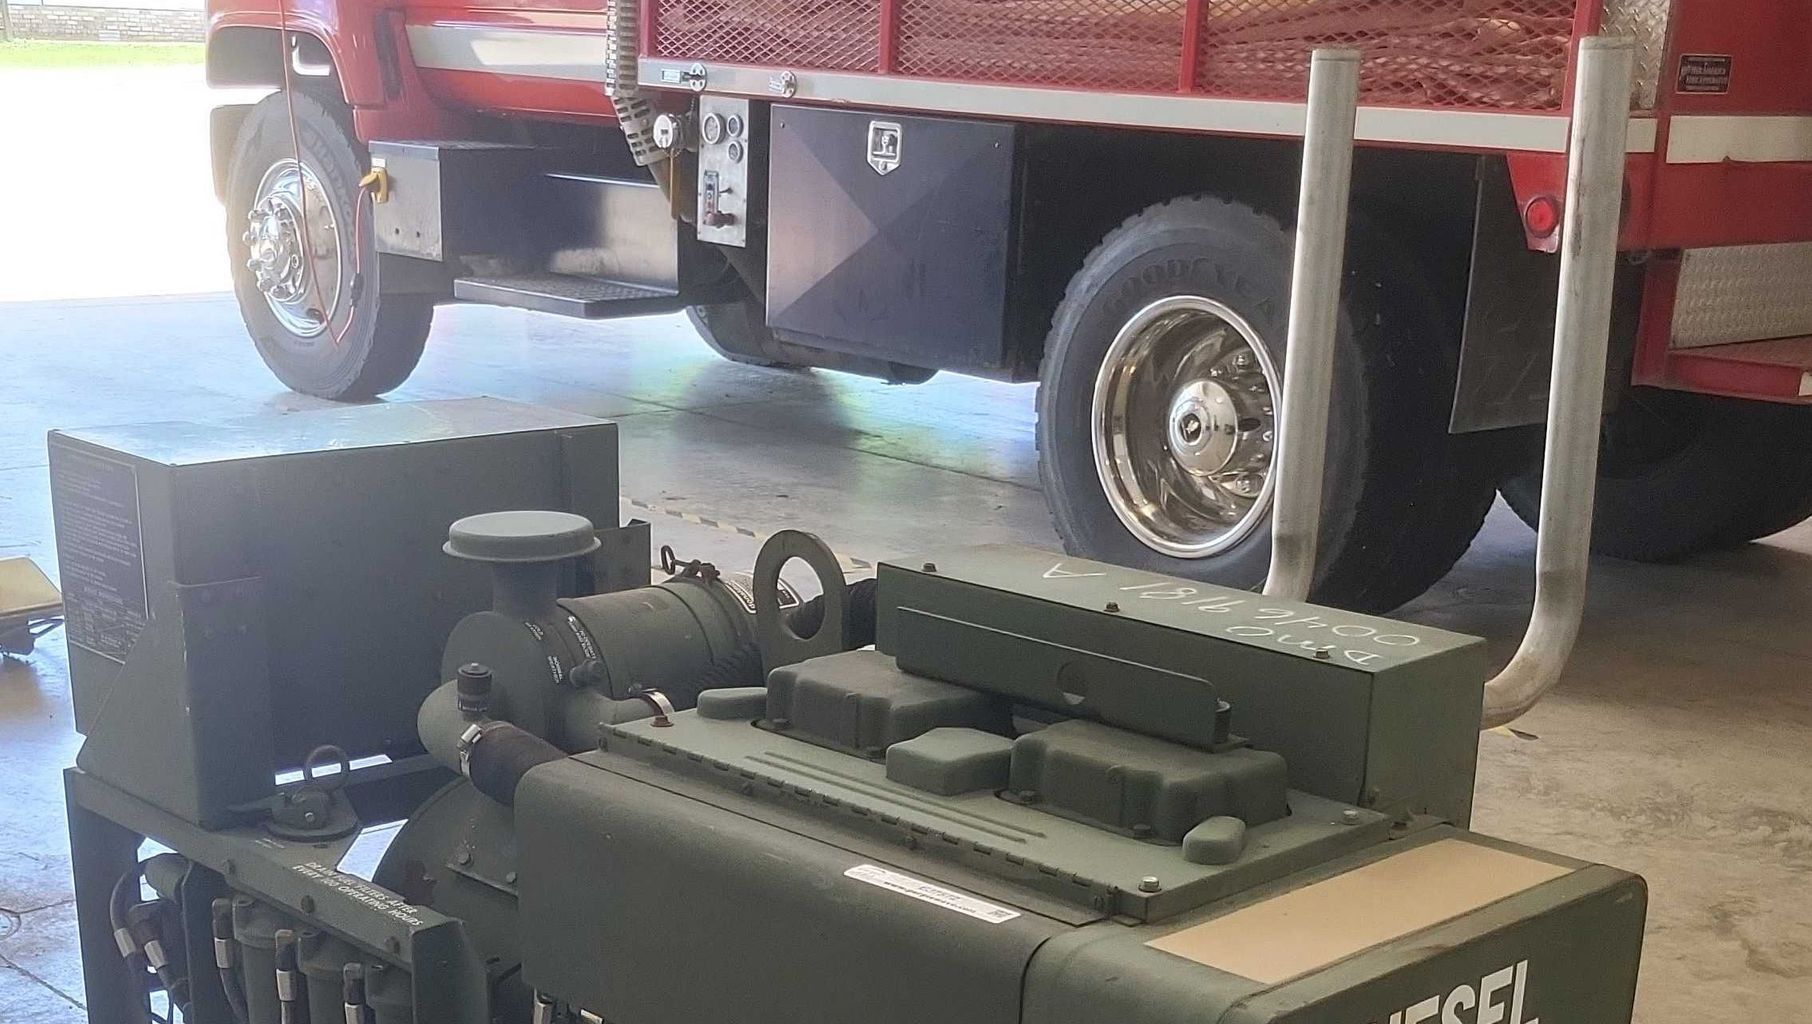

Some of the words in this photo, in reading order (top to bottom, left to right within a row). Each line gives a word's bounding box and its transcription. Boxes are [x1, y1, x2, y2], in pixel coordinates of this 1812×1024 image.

[337, 886, 390, 910] OPERATING
[387, 908, 424, 926] HOURS
[385, 899, 418, 914] AFTER
